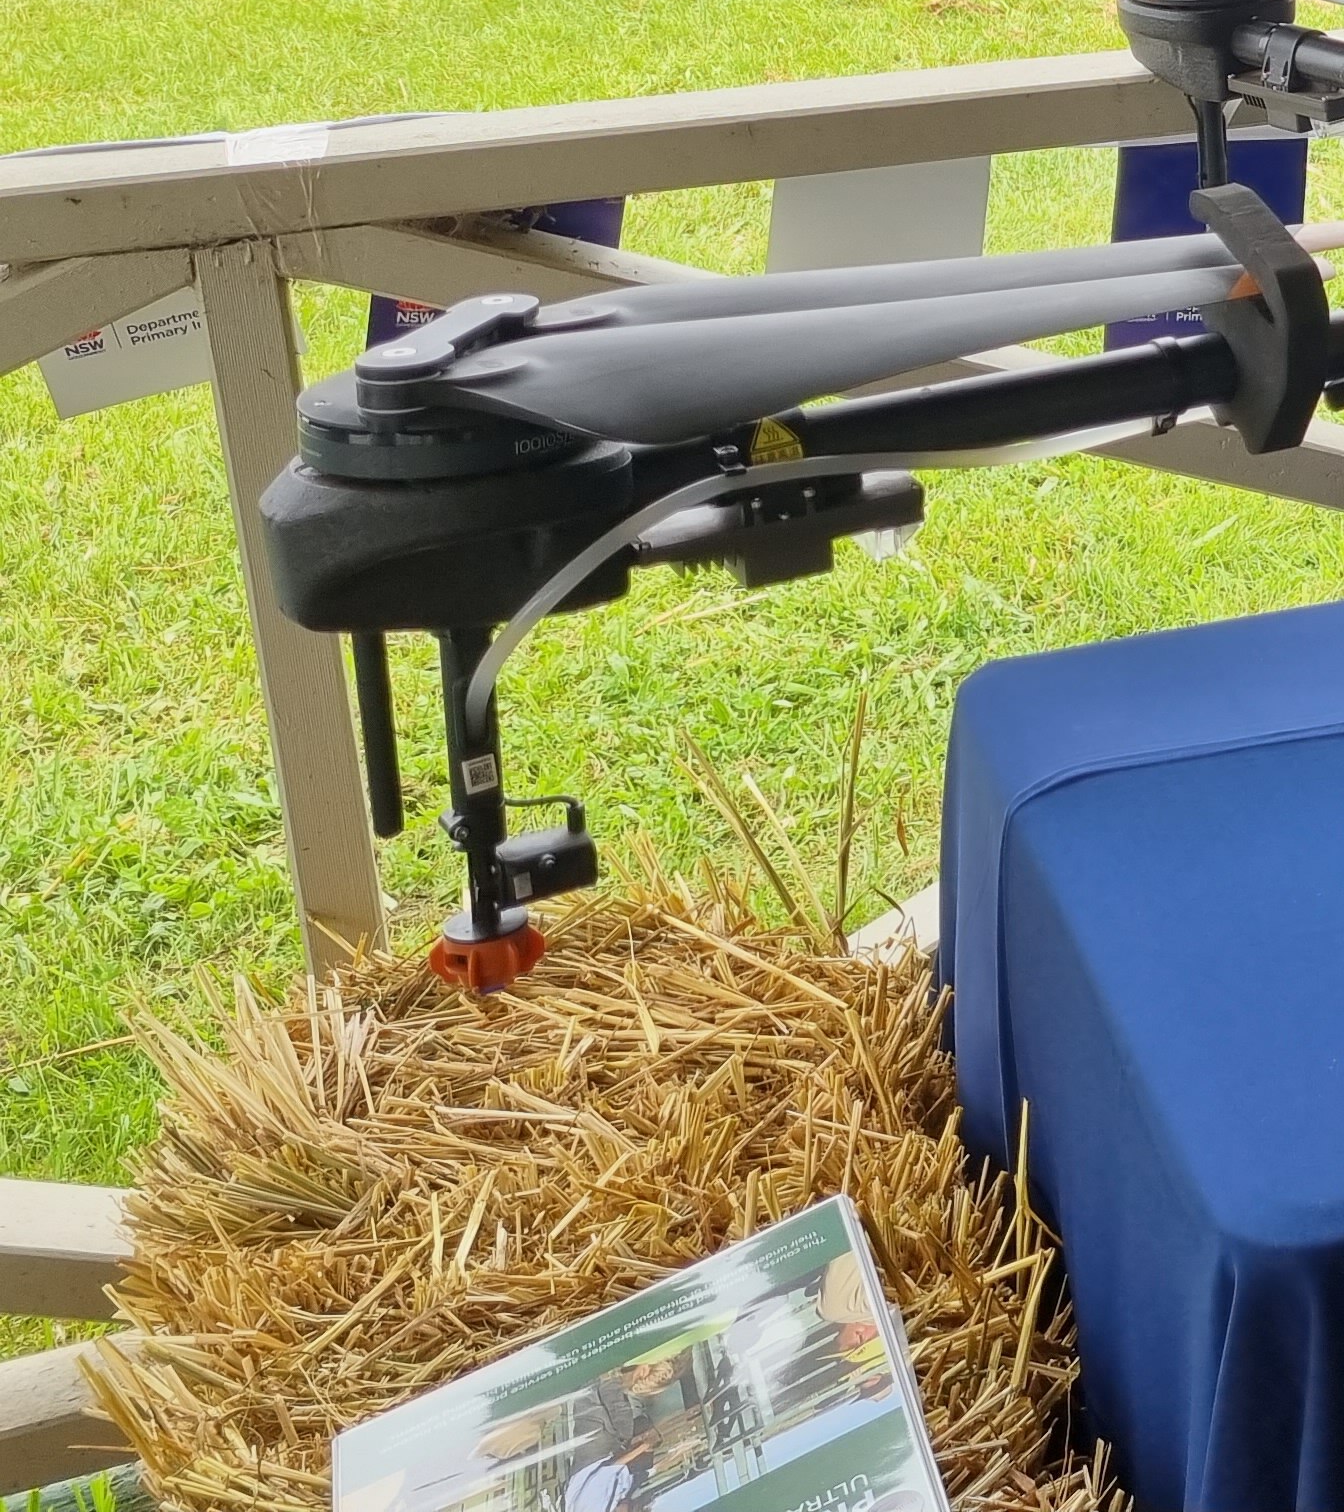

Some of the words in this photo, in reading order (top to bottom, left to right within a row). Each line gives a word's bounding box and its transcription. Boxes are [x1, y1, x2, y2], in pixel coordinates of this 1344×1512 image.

[126, 310, 200, 335] Departme
[396, 311, 435, 324] NSW
[131, 324, 188, 346] Primary
[64, 338, 105, 358] NSW
[789, 1229, 818, 1248] their
[801, 1234, 827, 1252] This
[760, 1245, 802, 1271] course
[620, 1293, 688, 1332] Ultrasound
[676, 1299, 694, 1313] for
[596, 1326, 623, 1344] and
[578, 1329, 634, 1361] breeders
[579, 1339, 597, 1353] its
[553, 1355, 580, 1374] and
[508, 1368, 554, 1396] service
